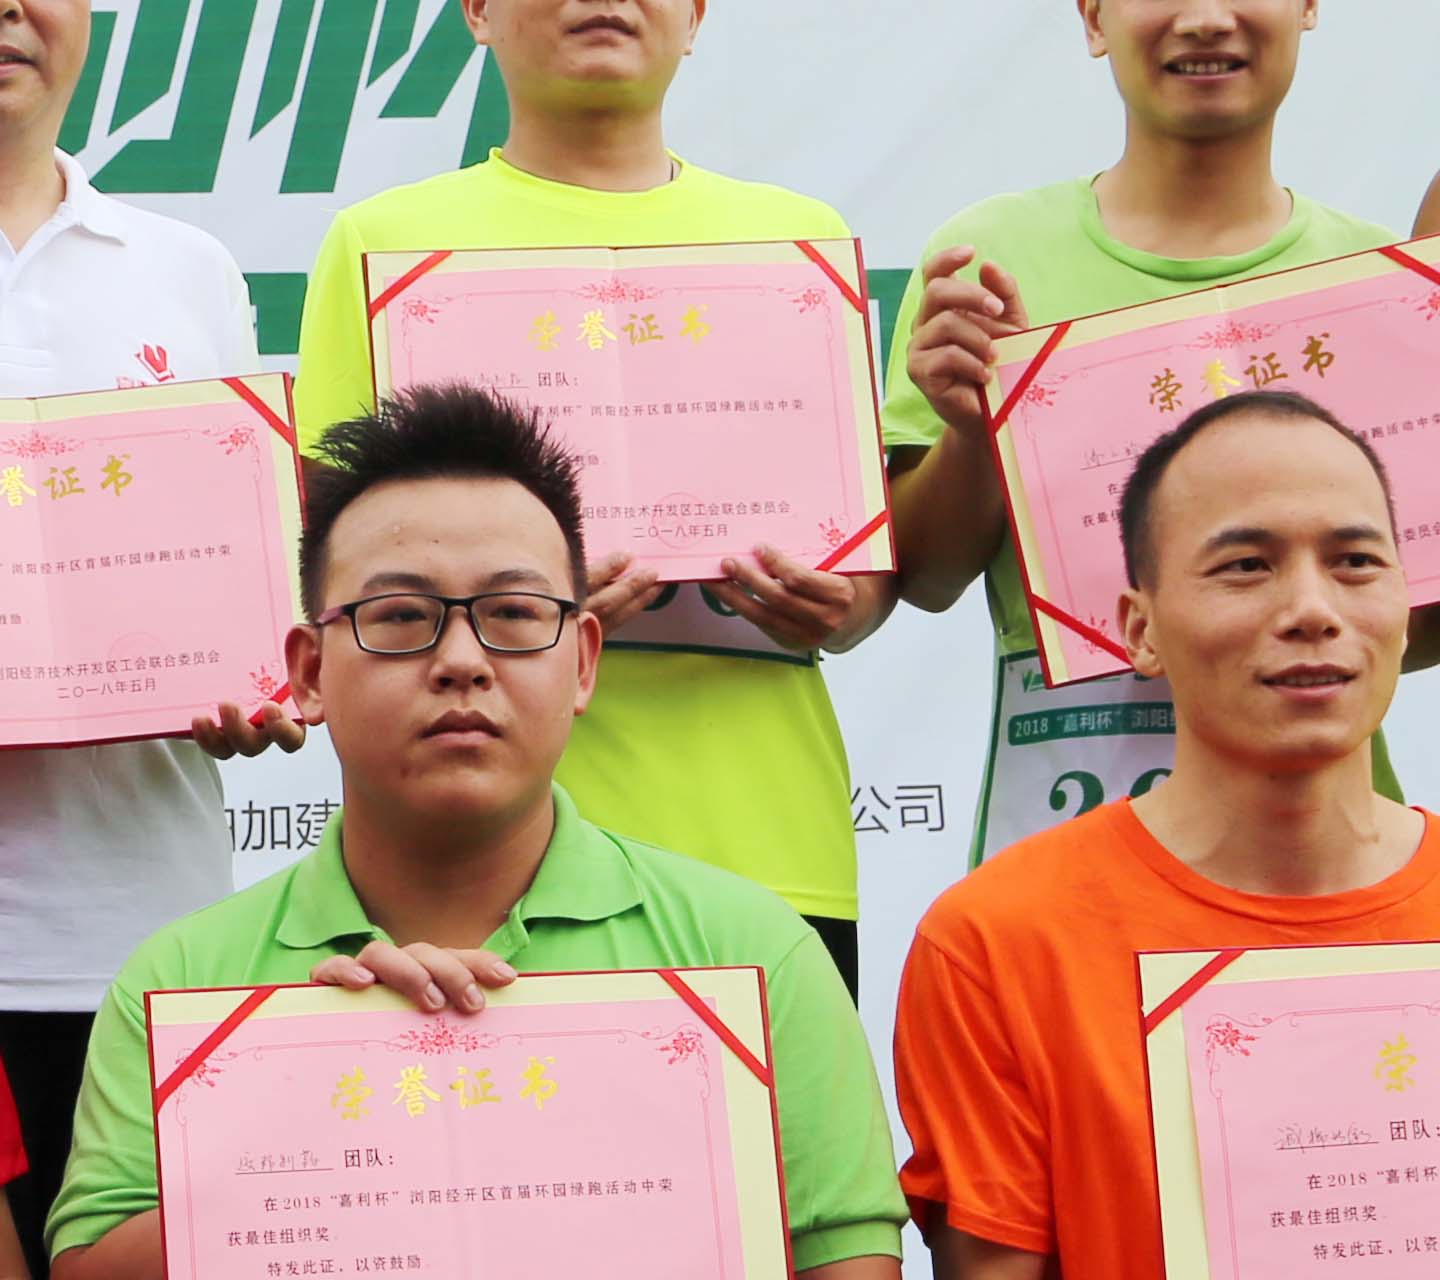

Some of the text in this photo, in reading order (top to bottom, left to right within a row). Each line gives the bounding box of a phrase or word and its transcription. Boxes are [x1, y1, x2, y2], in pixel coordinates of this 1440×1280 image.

[527, 303, 712, 352] 荣誉证书
[1148, 331, 1339, 413] 荣誉证书
[1014, 717, 1049, 738] 2018
[1130, 707, 1176, 729] 浏阳
[851, 783, 946, 835] 公司
[330, 1054, 559, 1121] 荣誉证书
